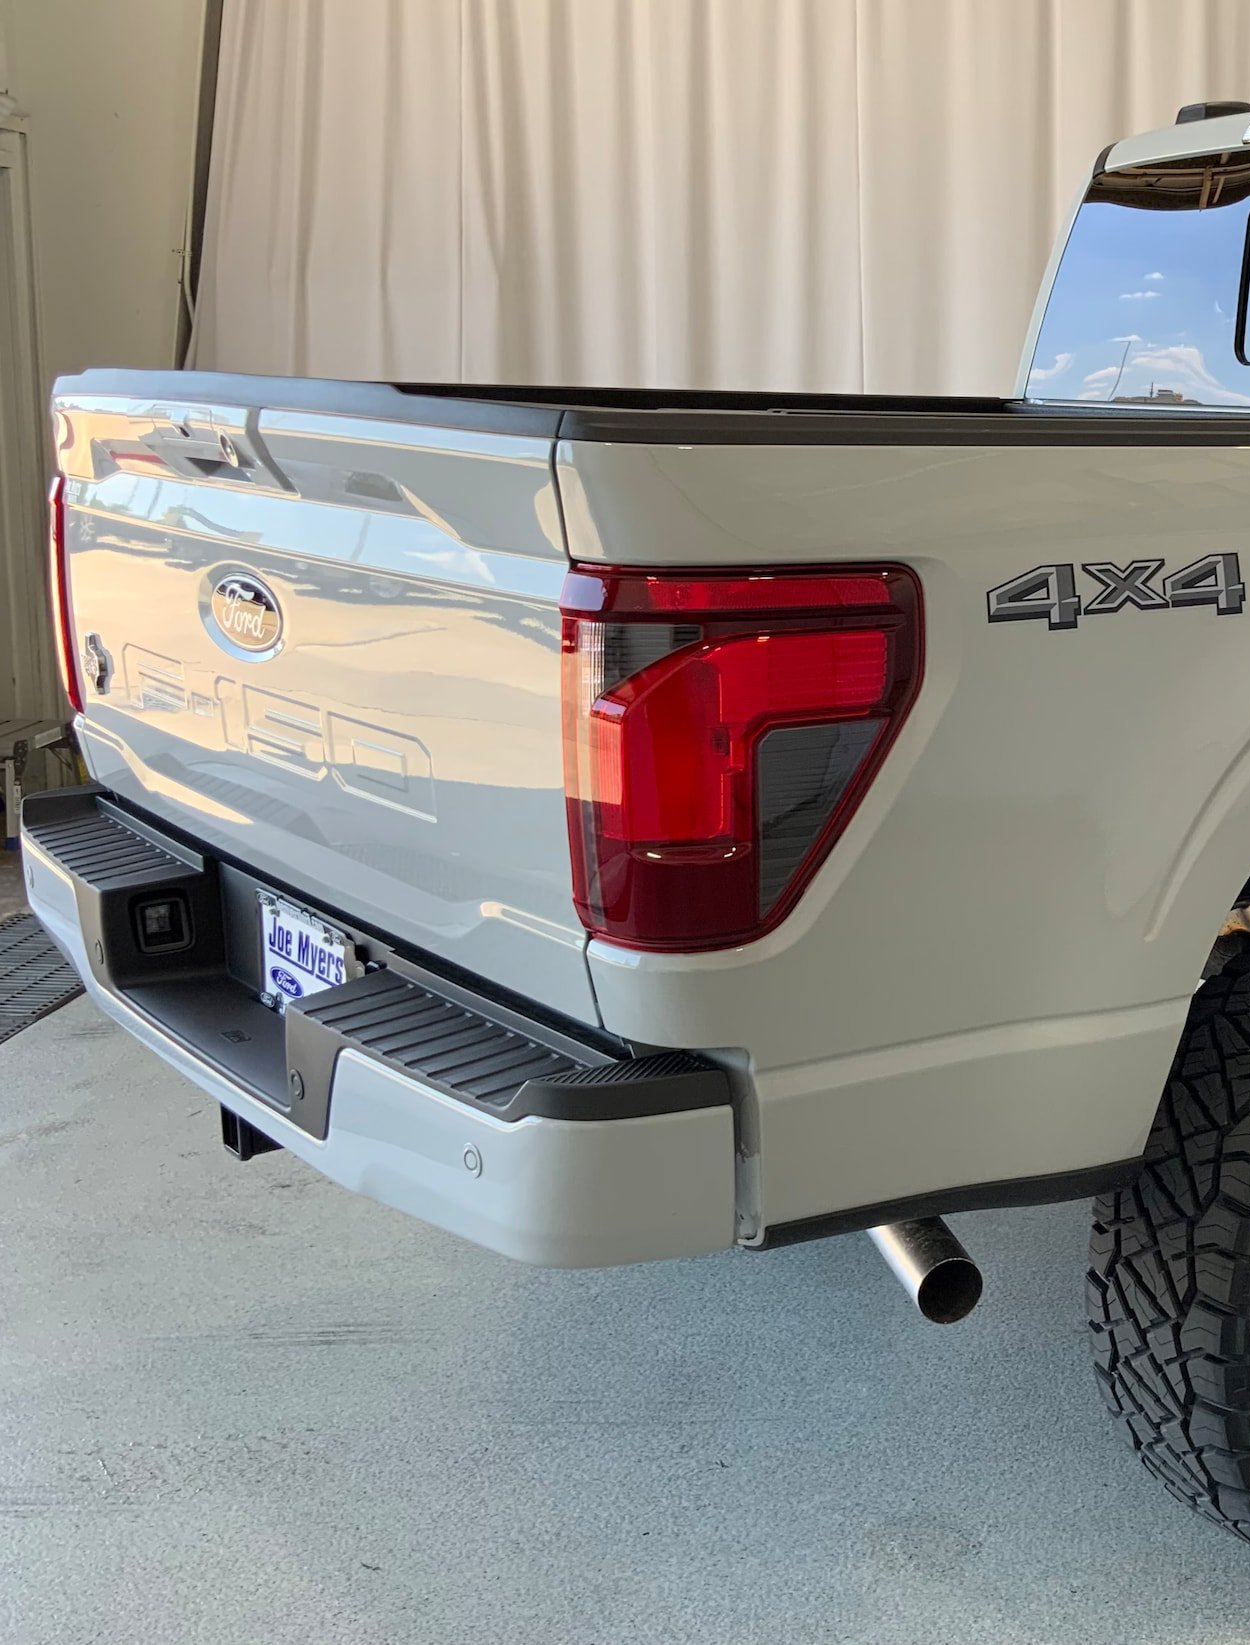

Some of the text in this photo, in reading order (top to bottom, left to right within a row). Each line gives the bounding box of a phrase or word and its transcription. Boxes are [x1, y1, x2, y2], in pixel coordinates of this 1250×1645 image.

[221, 582, 267, 639] Ford
[122, 643, 438, 824] F-150
[269, 916, 293, 957] Joe
[298, 930, 345, 985] Myers
[275, 970, 298, 995] Ford
